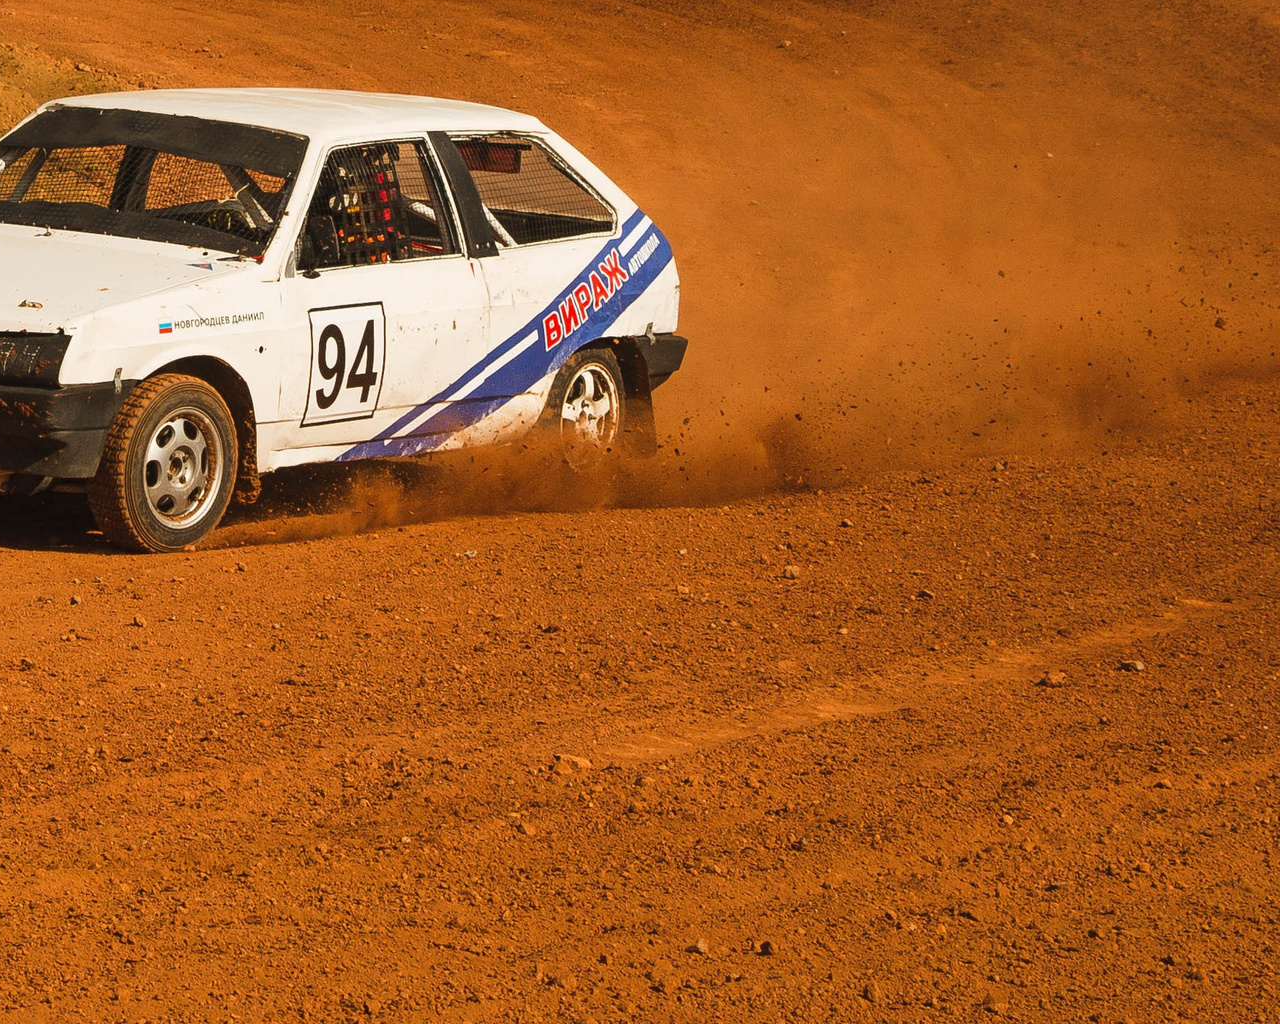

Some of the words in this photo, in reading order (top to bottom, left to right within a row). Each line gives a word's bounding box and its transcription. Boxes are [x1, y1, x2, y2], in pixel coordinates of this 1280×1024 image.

[174, 316, 230, 329] НОВГОРОДЦЕВ
[232, 312, 265, 324] ДАНИИЛ
[542, 248, 629, 353] ВИРАЖ
[316, 319, 378, 410] 94
